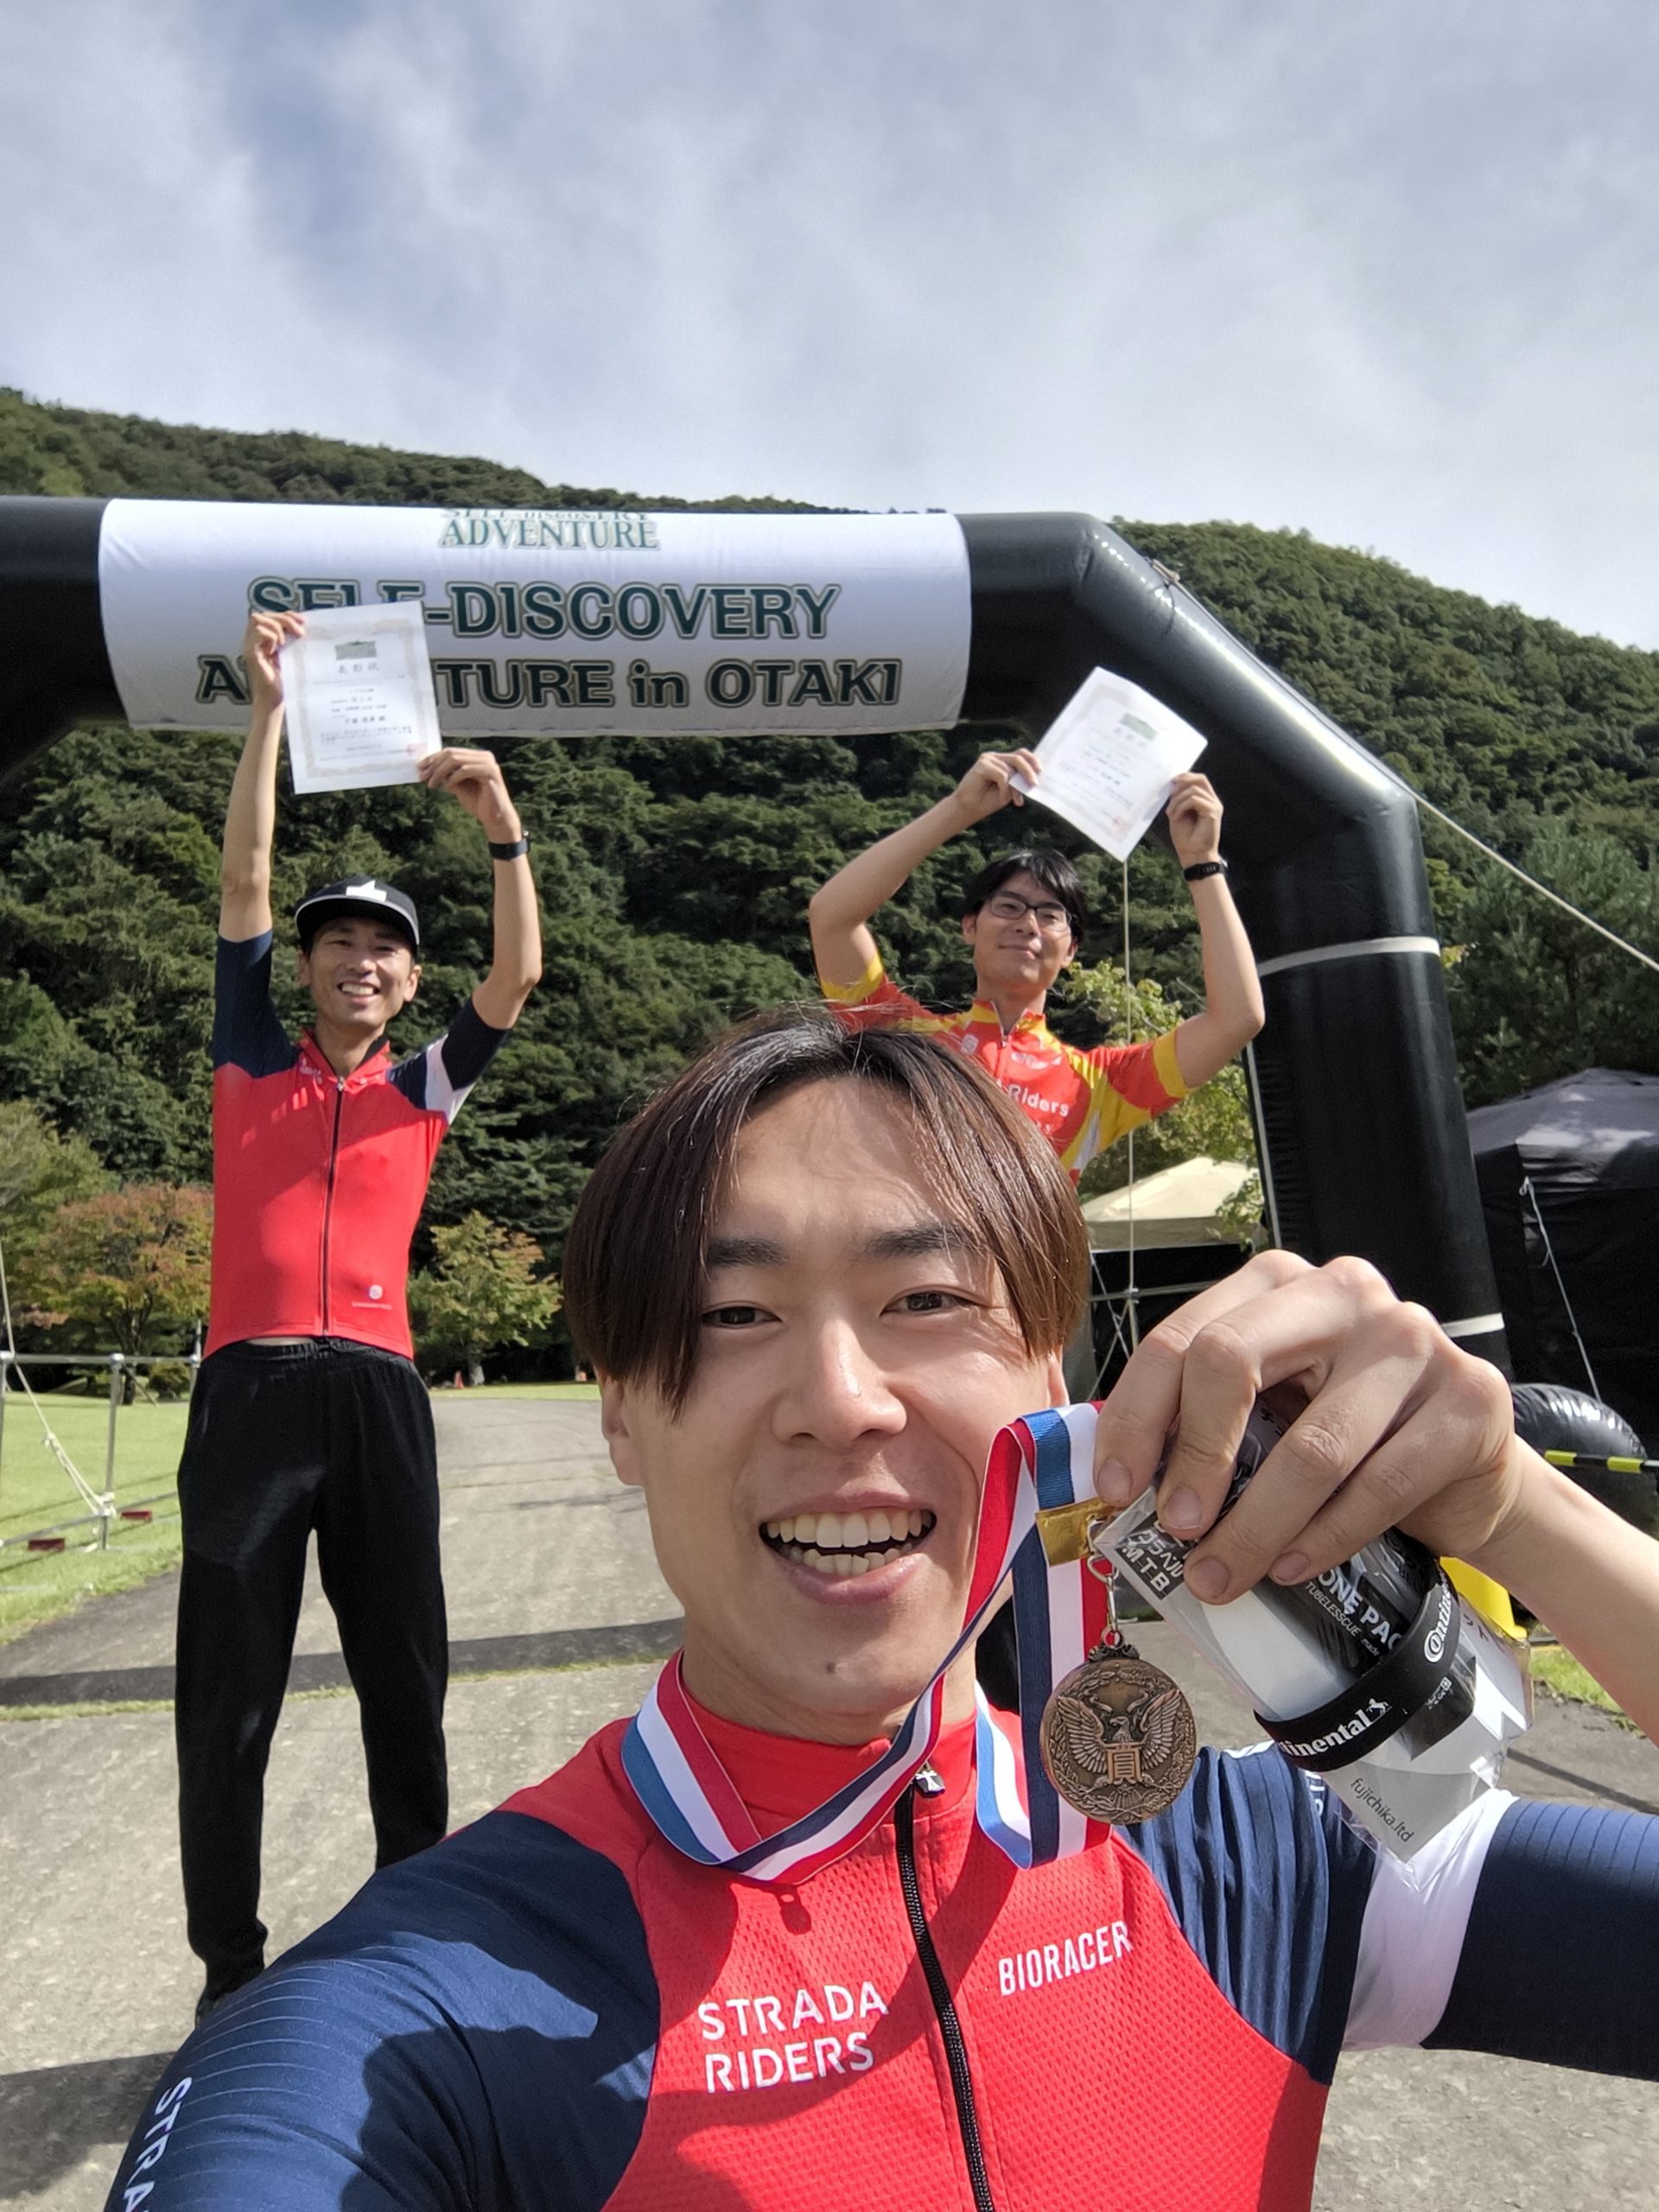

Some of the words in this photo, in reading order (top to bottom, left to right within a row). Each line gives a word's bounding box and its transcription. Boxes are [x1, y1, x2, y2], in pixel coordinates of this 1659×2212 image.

[441, 518, 658, 550] ADVENTURE
[197, 656, 614, 708] ATURE
[629, 659, 690, 707] in
[706, 659, 901, 707] OTAKI
[1318, 1565, 1363, 1614] ONE
[1350, 1777, 1415, 1843] fujichika.ltd
[998, 1920, 1133, 1998] BIORACER
[698, 1981, 889, 2041] STRADA
[704, 2031, 874, 2094] RIDERS
[123, 2076, 193, 2212] STRA
